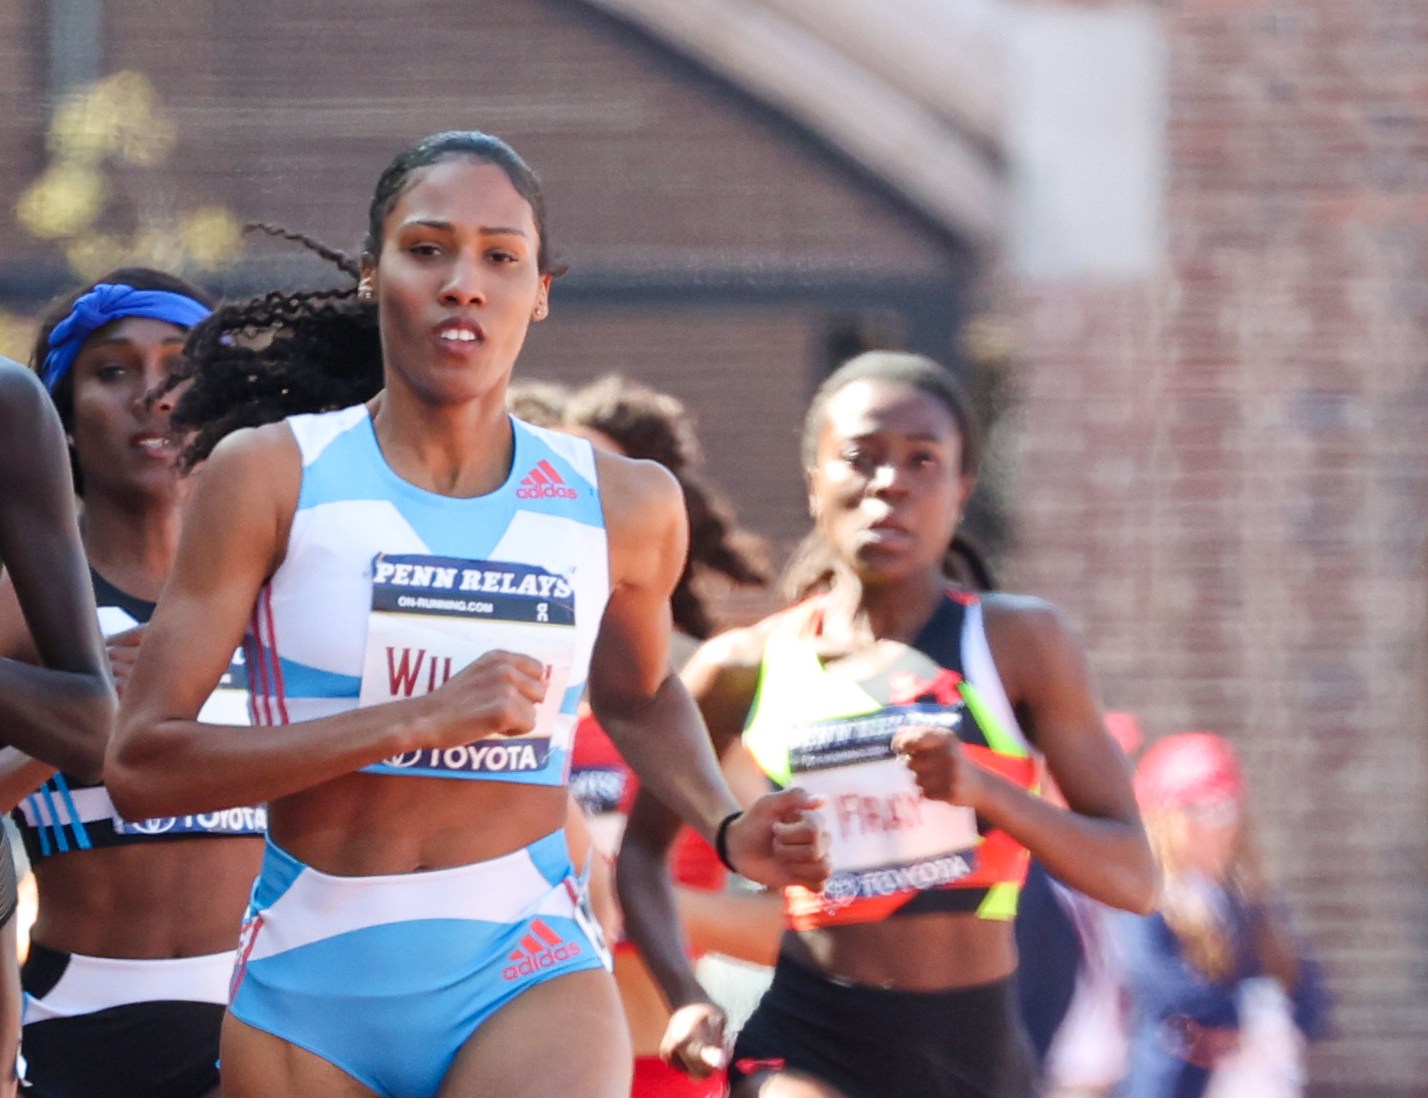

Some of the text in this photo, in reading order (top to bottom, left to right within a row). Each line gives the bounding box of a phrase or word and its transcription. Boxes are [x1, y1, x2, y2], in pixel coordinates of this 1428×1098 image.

[516, 483, 578, 500] adidas
[373, 562, 572, 599] PENN RELAYS
[398, 595, 494, 613] ON-RUNNING.COM
[501, 941, 582, 983] adidas
